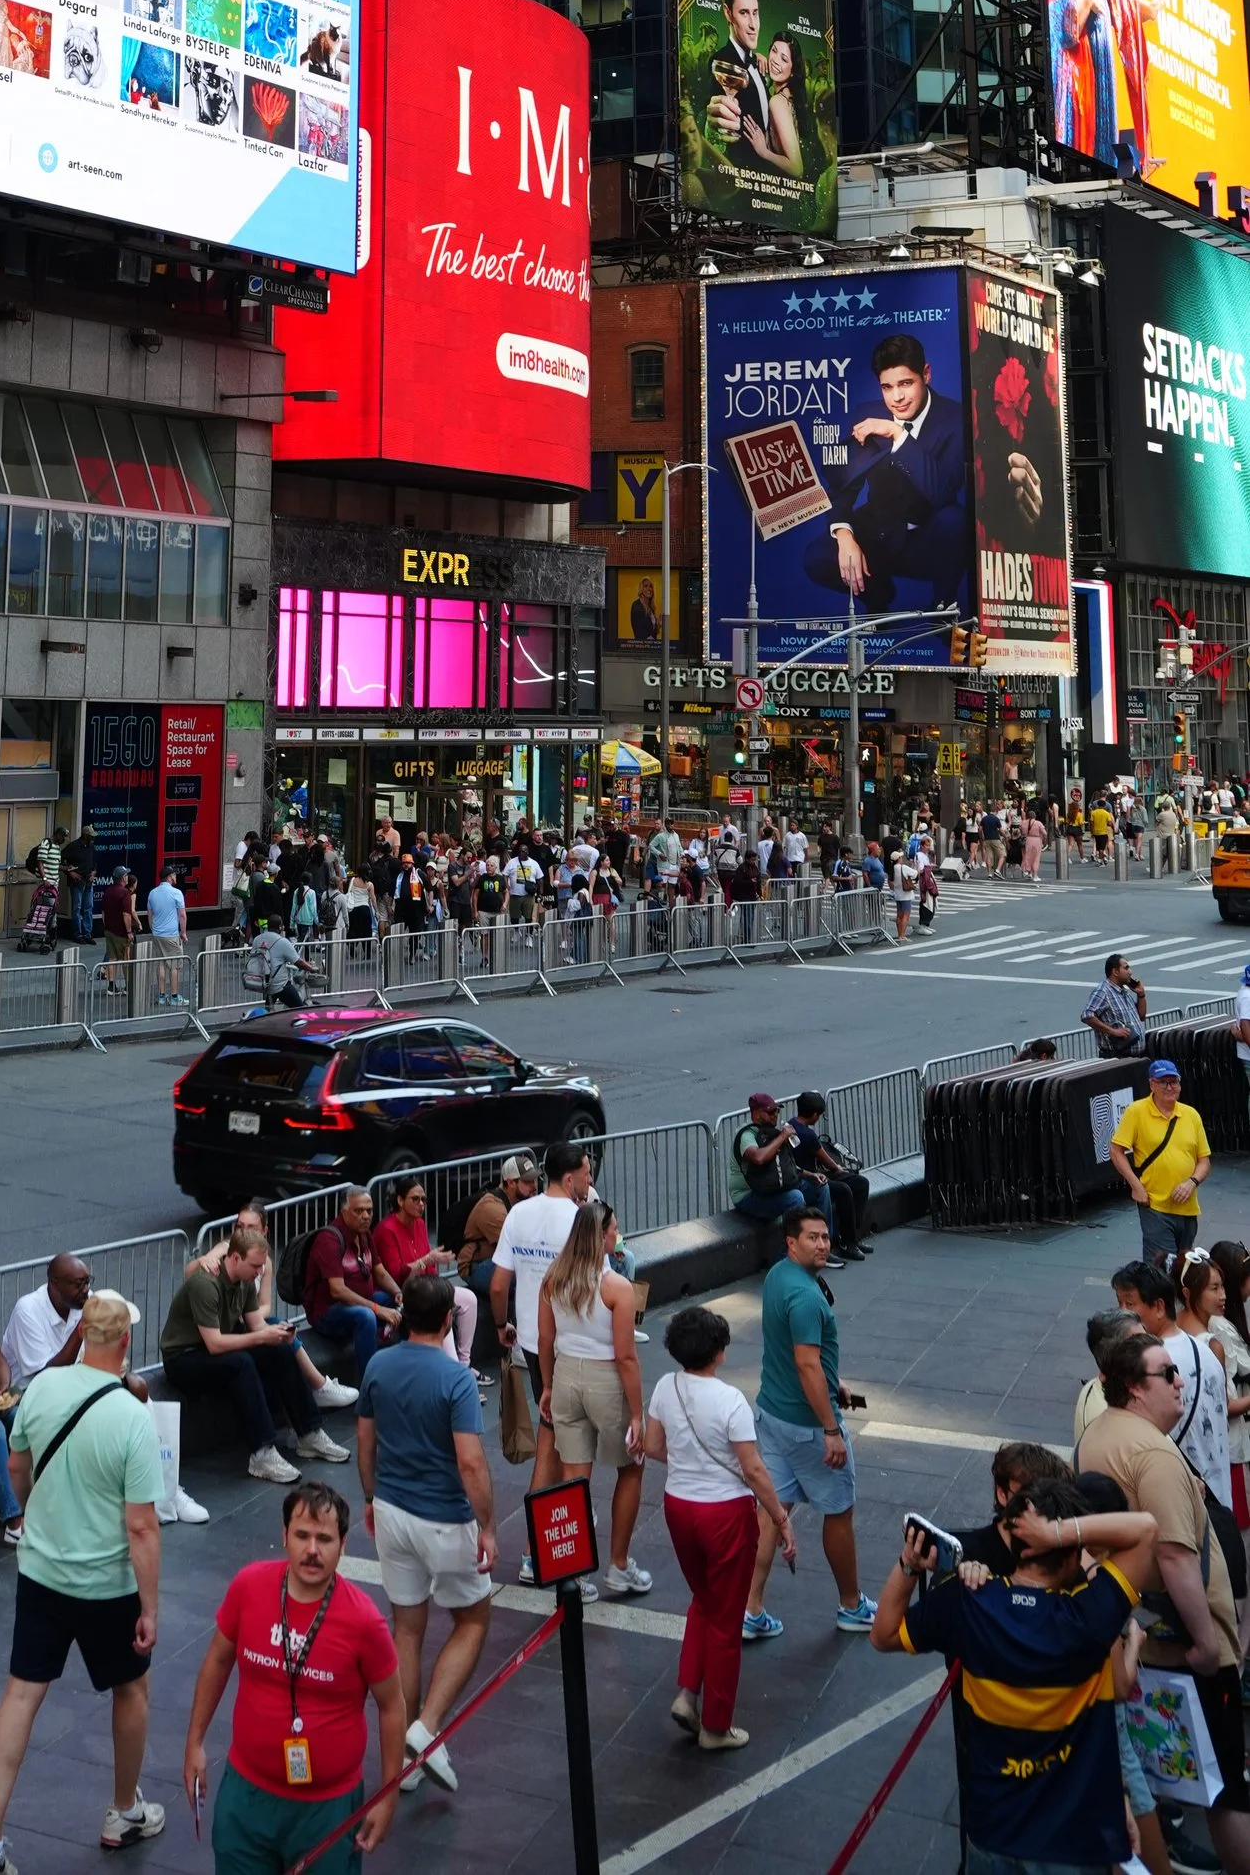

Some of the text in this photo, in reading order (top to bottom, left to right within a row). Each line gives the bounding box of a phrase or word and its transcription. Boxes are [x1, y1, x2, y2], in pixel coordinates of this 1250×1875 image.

[123, 16, 181, 45] Linda Laforge
[787, 23, 821, 38] NOBLEZADA
[799, 16, 810, 25] EVA
[185, 35, 230, 59] BYSTELPE
[1157, 9, 1218, 77] WINNING
[244, 55, 282, 76] EDENIVA
[244, 139, 284, 159] Tinted Can
[68, 160, 123, 181] art-seen.com
[299, 153, 328, 173] Lazfar
[723, 166, 814, 192] THE BROADWAY THEATRE
[754, 183, 760, 191] &
[761, 184, 801, 199] BROADWAY
[422, 223, 468, 277] The
[471, 233, 525, 285] best
[524, 244, 575, 295] choose
[985, 281, 1003, 307] COME
[1004, 287, 1015, 311] SEE
[733, 320, 780, 334] HELLUVA
[784, 317, 824, 331] GOOD
[829, 315, 854, 328] TIME
[856, 316, 870, 326] at
[872, 313, 893, 325] the
[974, 302, 1054, 353] WORLD COULD BE
[509, 345, 586, 387] im8health.com
[724, 357, 851, 383] JEREMY
[1143, 323, 1246, 400] SETBACKS
[724, 381, 848, 419] JORDAN
[1144, 378, 1235, 448] HAPPEN.
[813, 425, 840, 445] BOBBY
[623, 457, 657, 465] MUSICAL
[743, 439, 798, 475] JUST in
[823, 445, 848, 465] DARIN
[778, 518, 796, 529] NEW
[797, 505, 828, 521] MUSICAL
[981, 550, 1068, 605] HADESTOWN
[982, 603, 1068, 621] BROADWAY'S GLOBAL SENSATION
[683, 702, 712, 714] Nikon
[1020, 710, 1037, 718] SONY
[168, 717, 197, 730] Retail/
[91, 715, 156, 767] 1560
[167, 731, 215, 743] Restaurant
[166, 744, 208, 757] Space for
[942, 745, 951, 770] ATM
[166, 757, 192, 768] Lease
[395, 760, 503, 777] GIFTS LUGGAGE
[91, 769, 154, 788] BROADWAY
[551, 1505, 568, 1523] JOIN
[544, 1520, 578, 1543] THE LINE
[552, 1540, 575, 1560] HERE!
